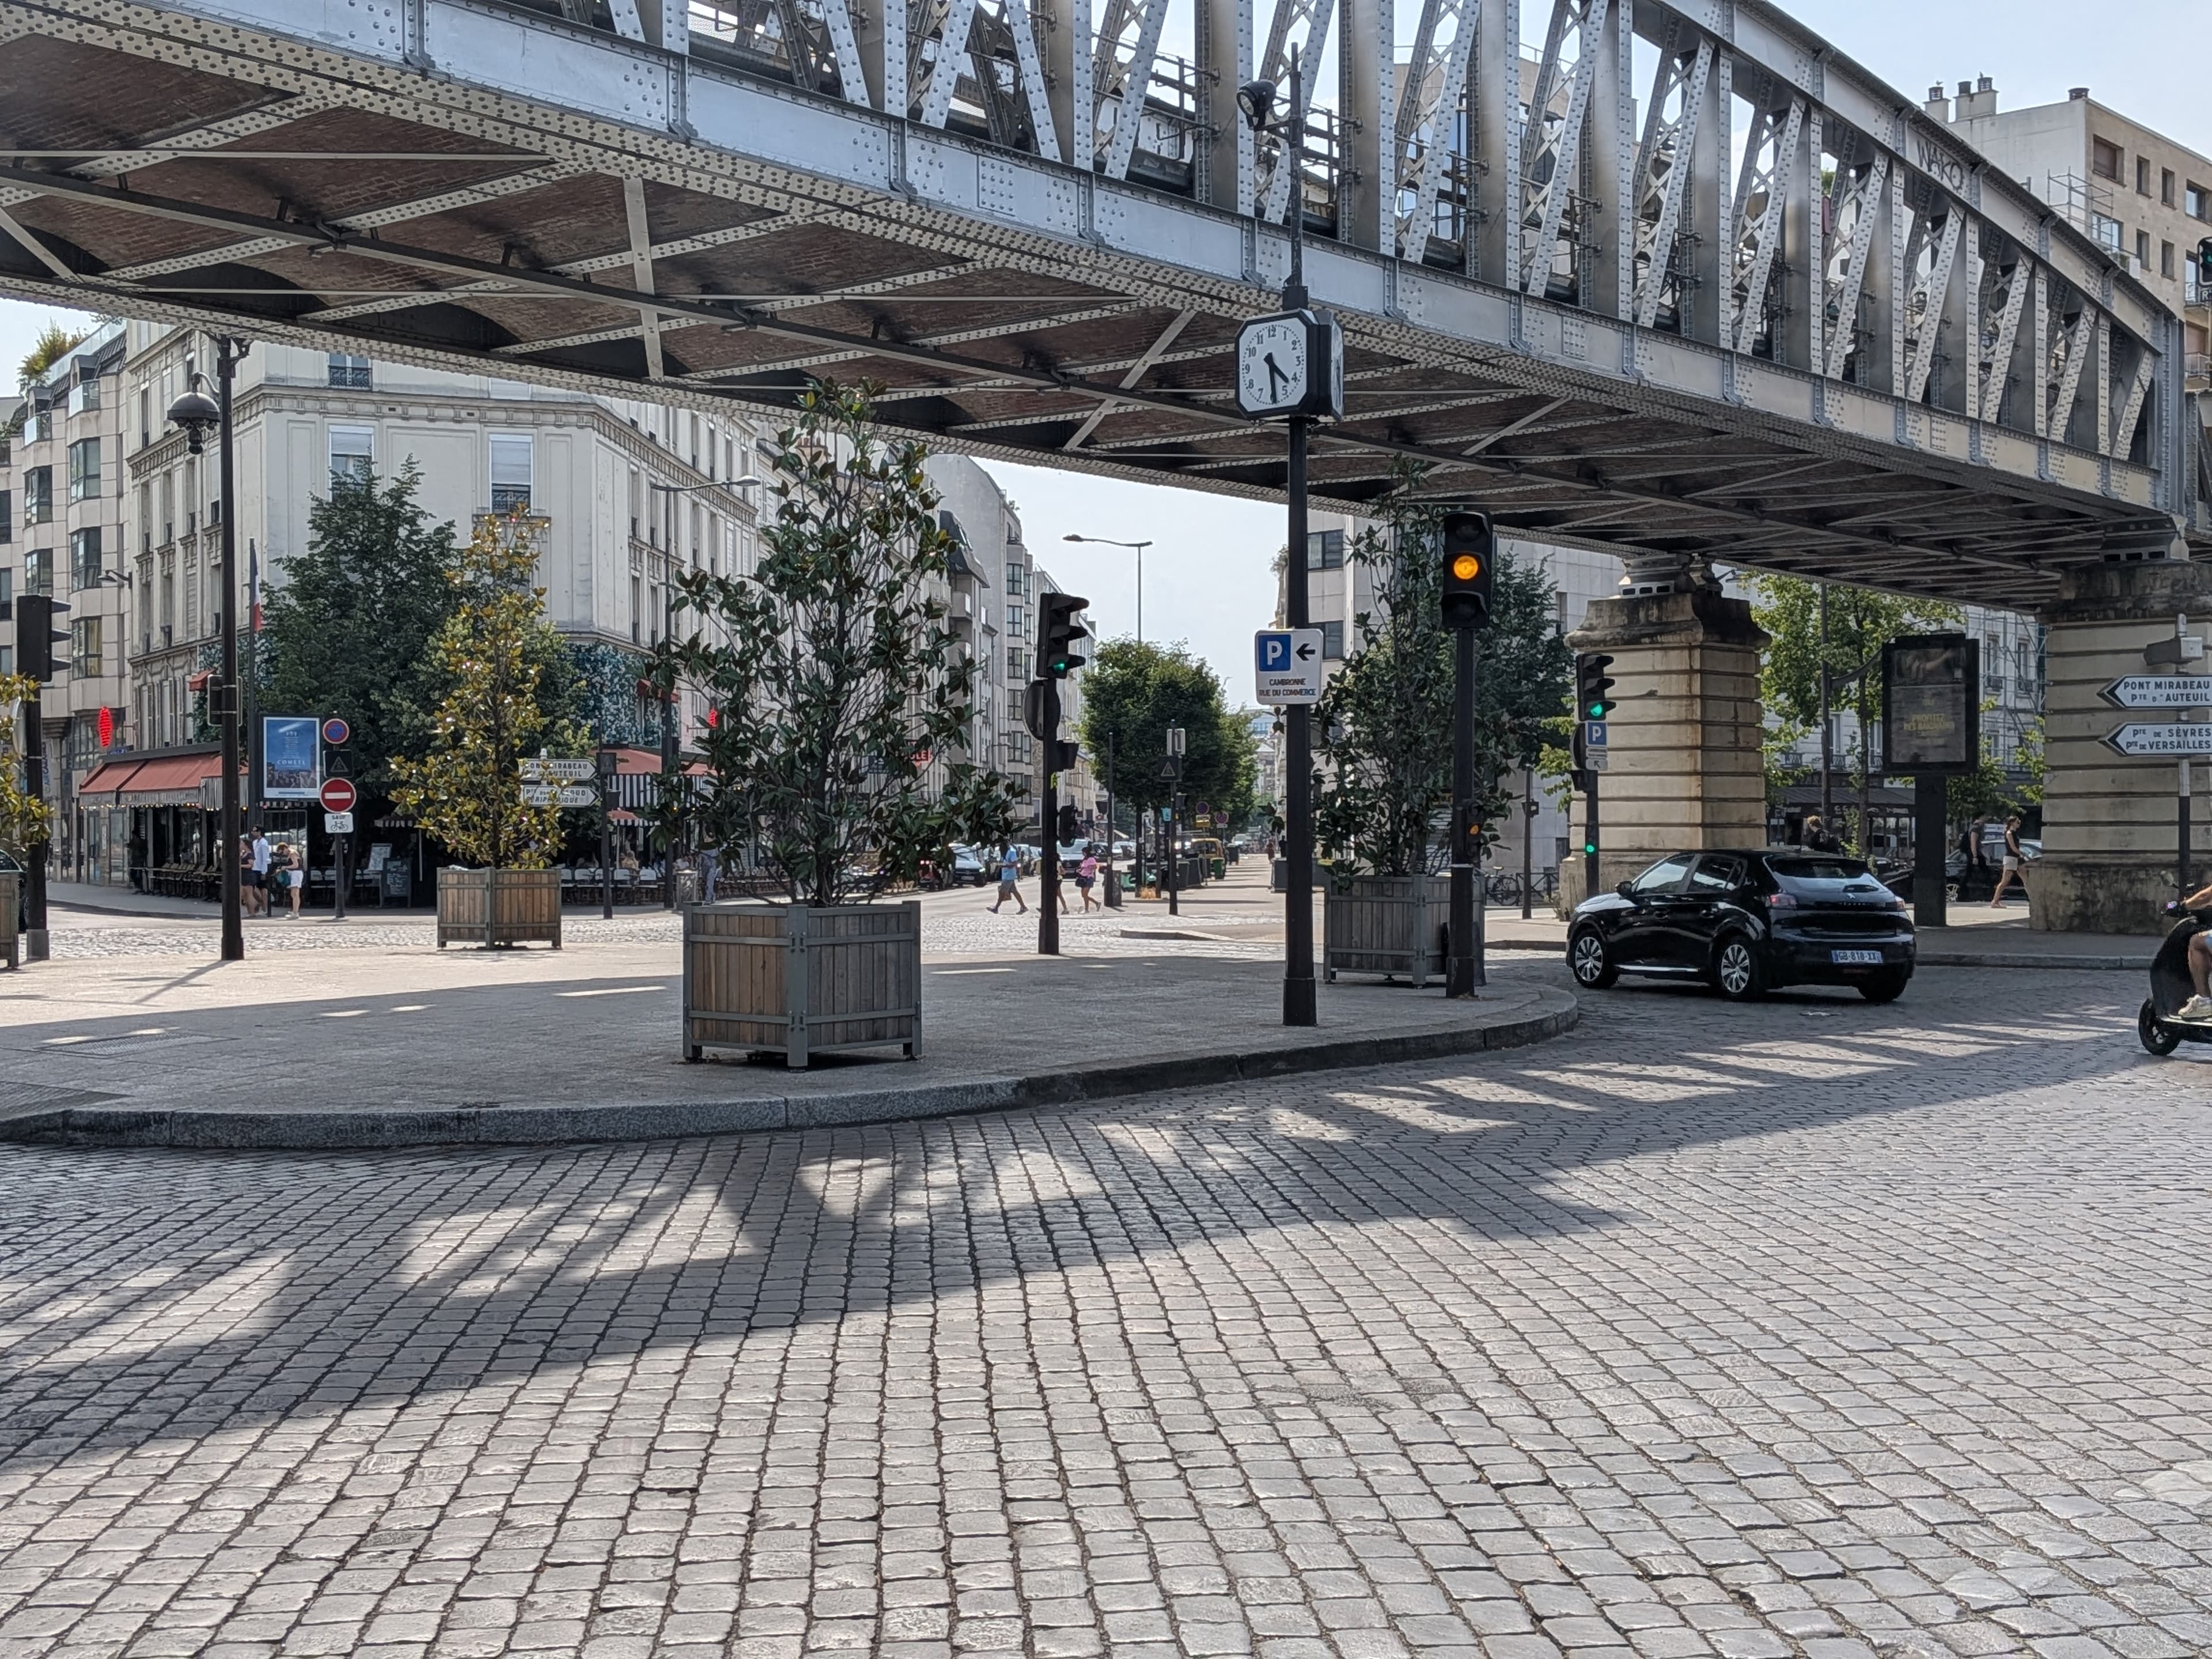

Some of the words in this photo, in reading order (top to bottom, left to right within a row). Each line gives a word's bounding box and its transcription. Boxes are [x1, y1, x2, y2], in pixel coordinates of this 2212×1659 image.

[1267, 327, 1277, 338] 12
[1283, 331, 1287, 340] 1
[1256, 334, 1263, 344] 11
[1291, 340, 1297, 350] 2
[1248, 347, 1256, 357] 10
[1296, 356, 1301, 366] 3
[1245, 363, 1250, 374] 9
[1291, 372, 1298, 382] 4
[1248, 379, 1254, 389] 8
[1257, 388, 1263, 399] 7
[1282, 385, 1288, 396] 5
[1267, 641, 1283, 665] P
[1269, 678, 1306, 686] CAMBRONNE
[2124, 681, 2151, 690] PONT
[2154, 680, 2210, 690] MIRABEAU
[1592, 726, 1602, 741] P
[2168, 726, 2211, 737] SÈVRES
[2148, 741, 2211, 750] VERSAILLES
